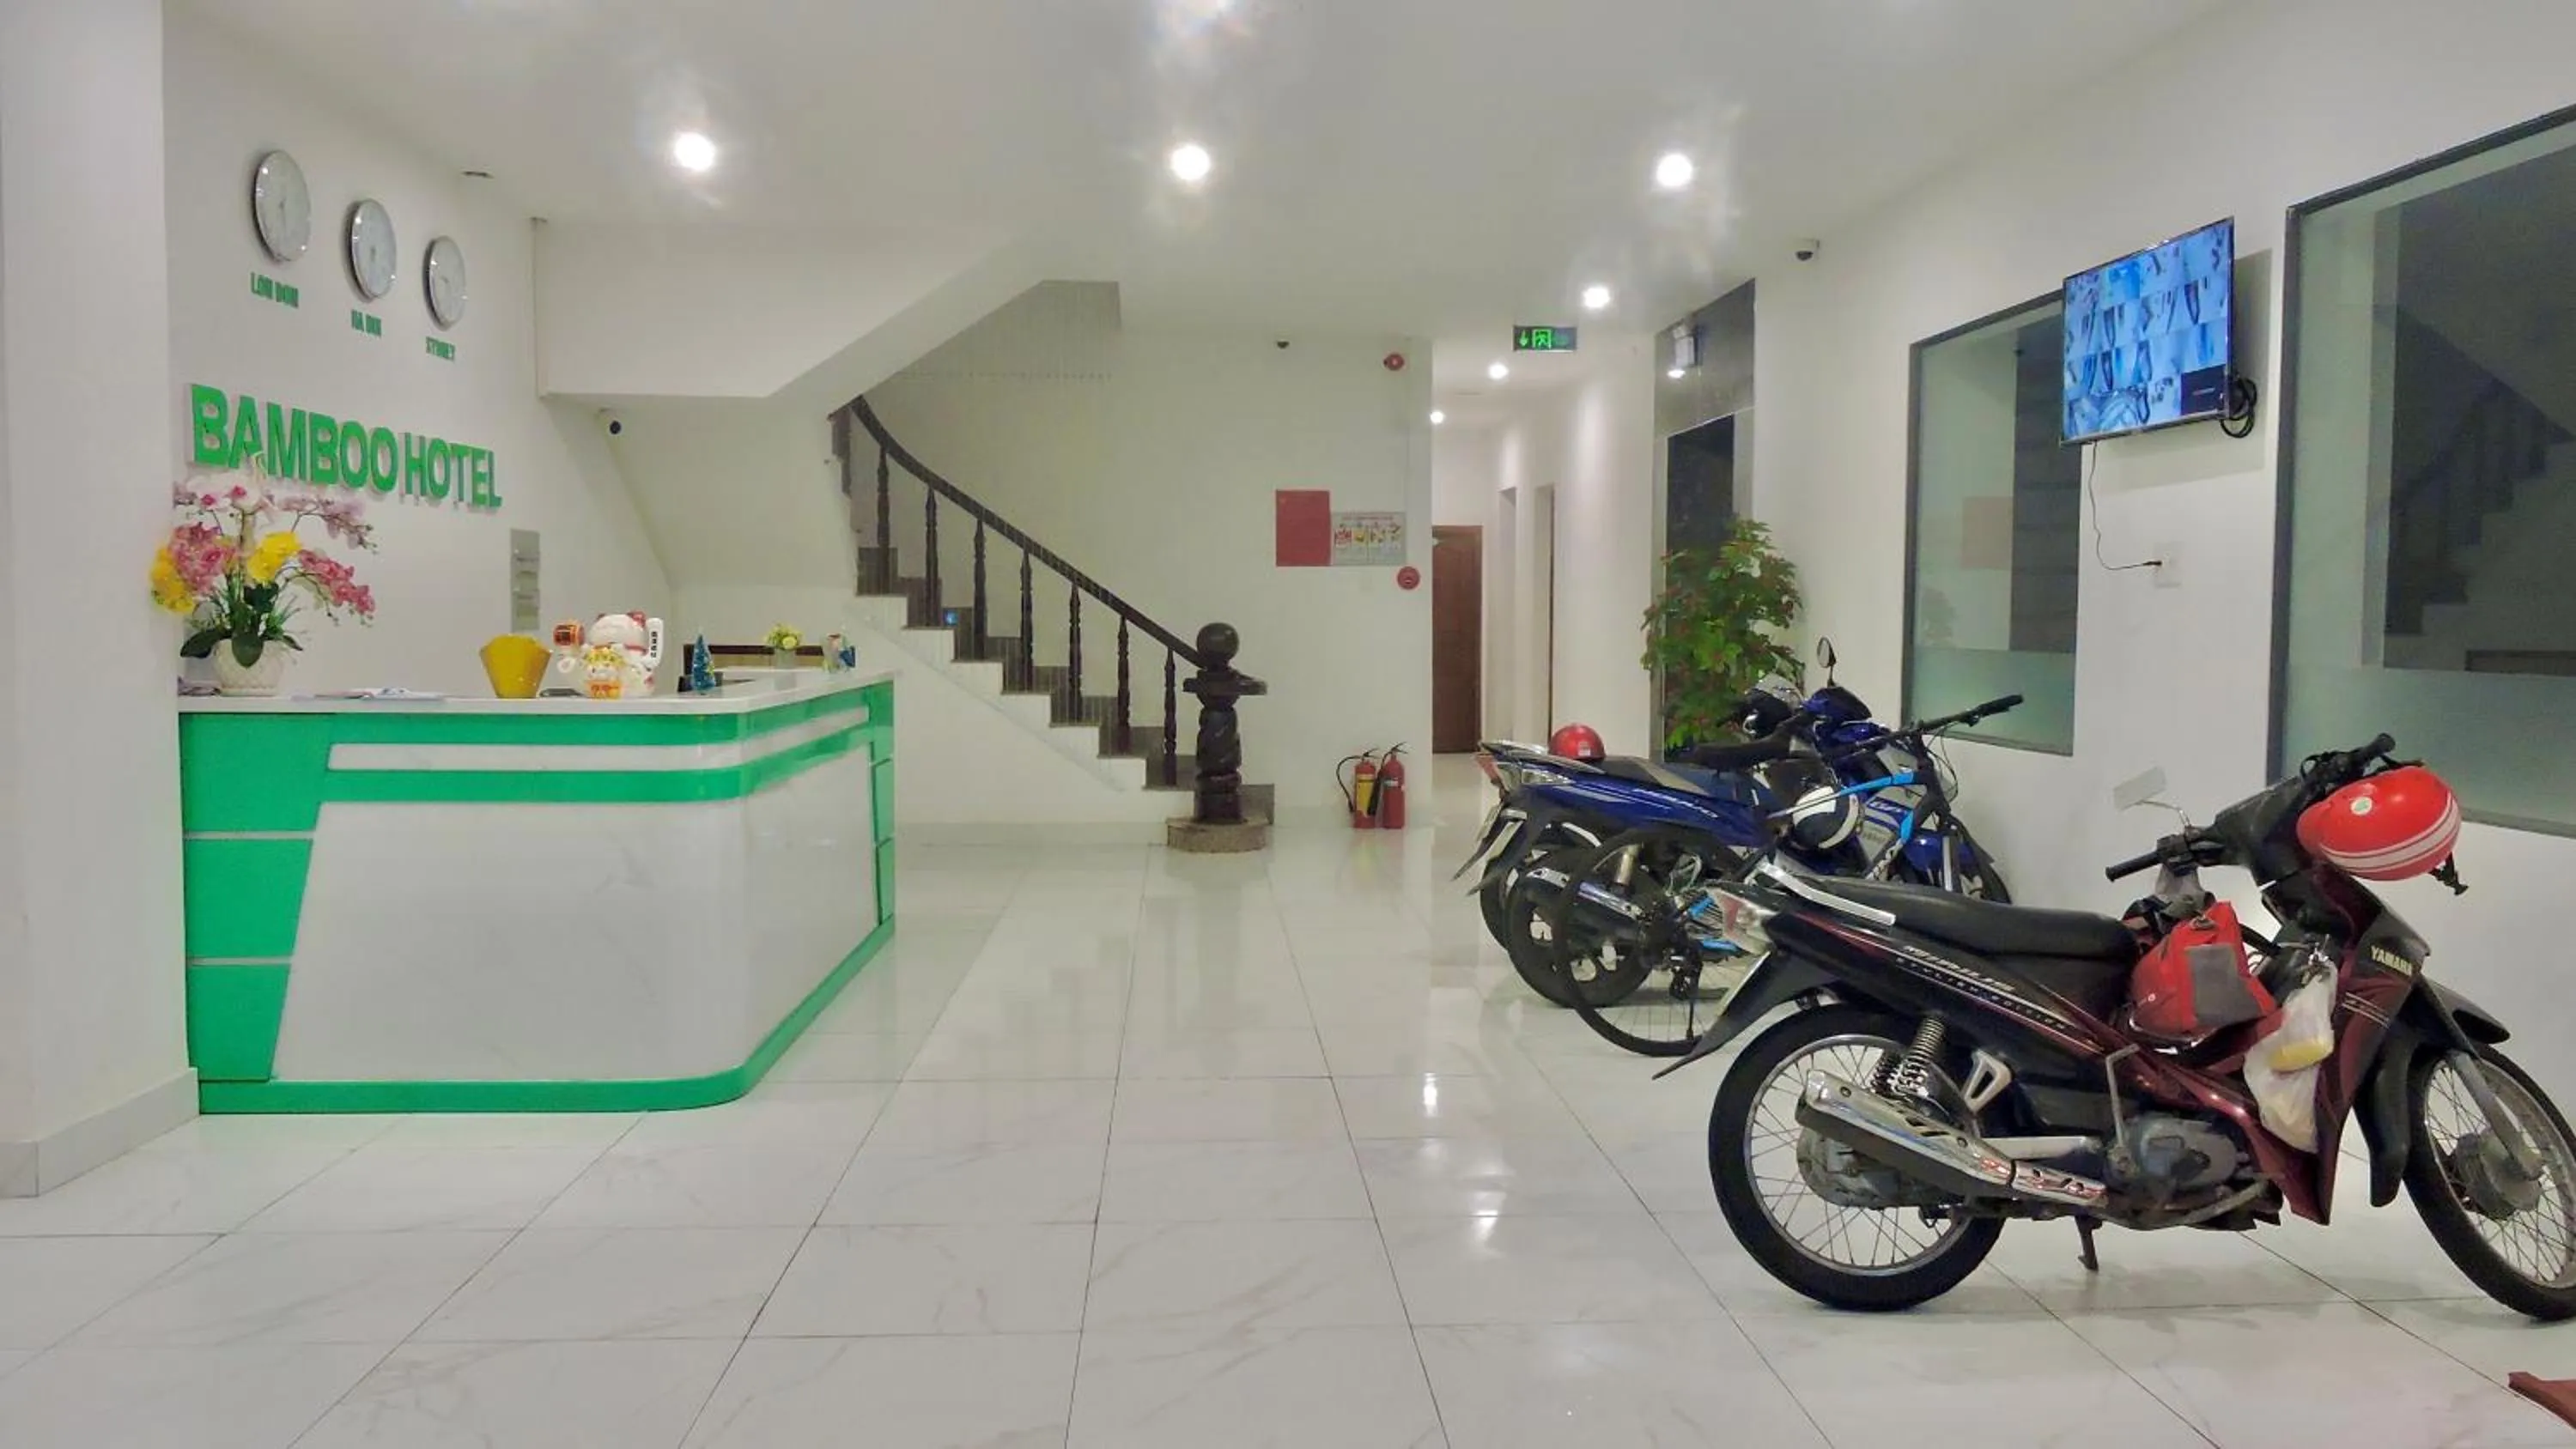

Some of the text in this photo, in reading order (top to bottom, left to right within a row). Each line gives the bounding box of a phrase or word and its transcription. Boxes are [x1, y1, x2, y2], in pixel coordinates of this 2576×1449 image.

[191, 384, 502, 507] BAMBOO HOTEL
[2371, 945, 2412, 976] YAMAHA
